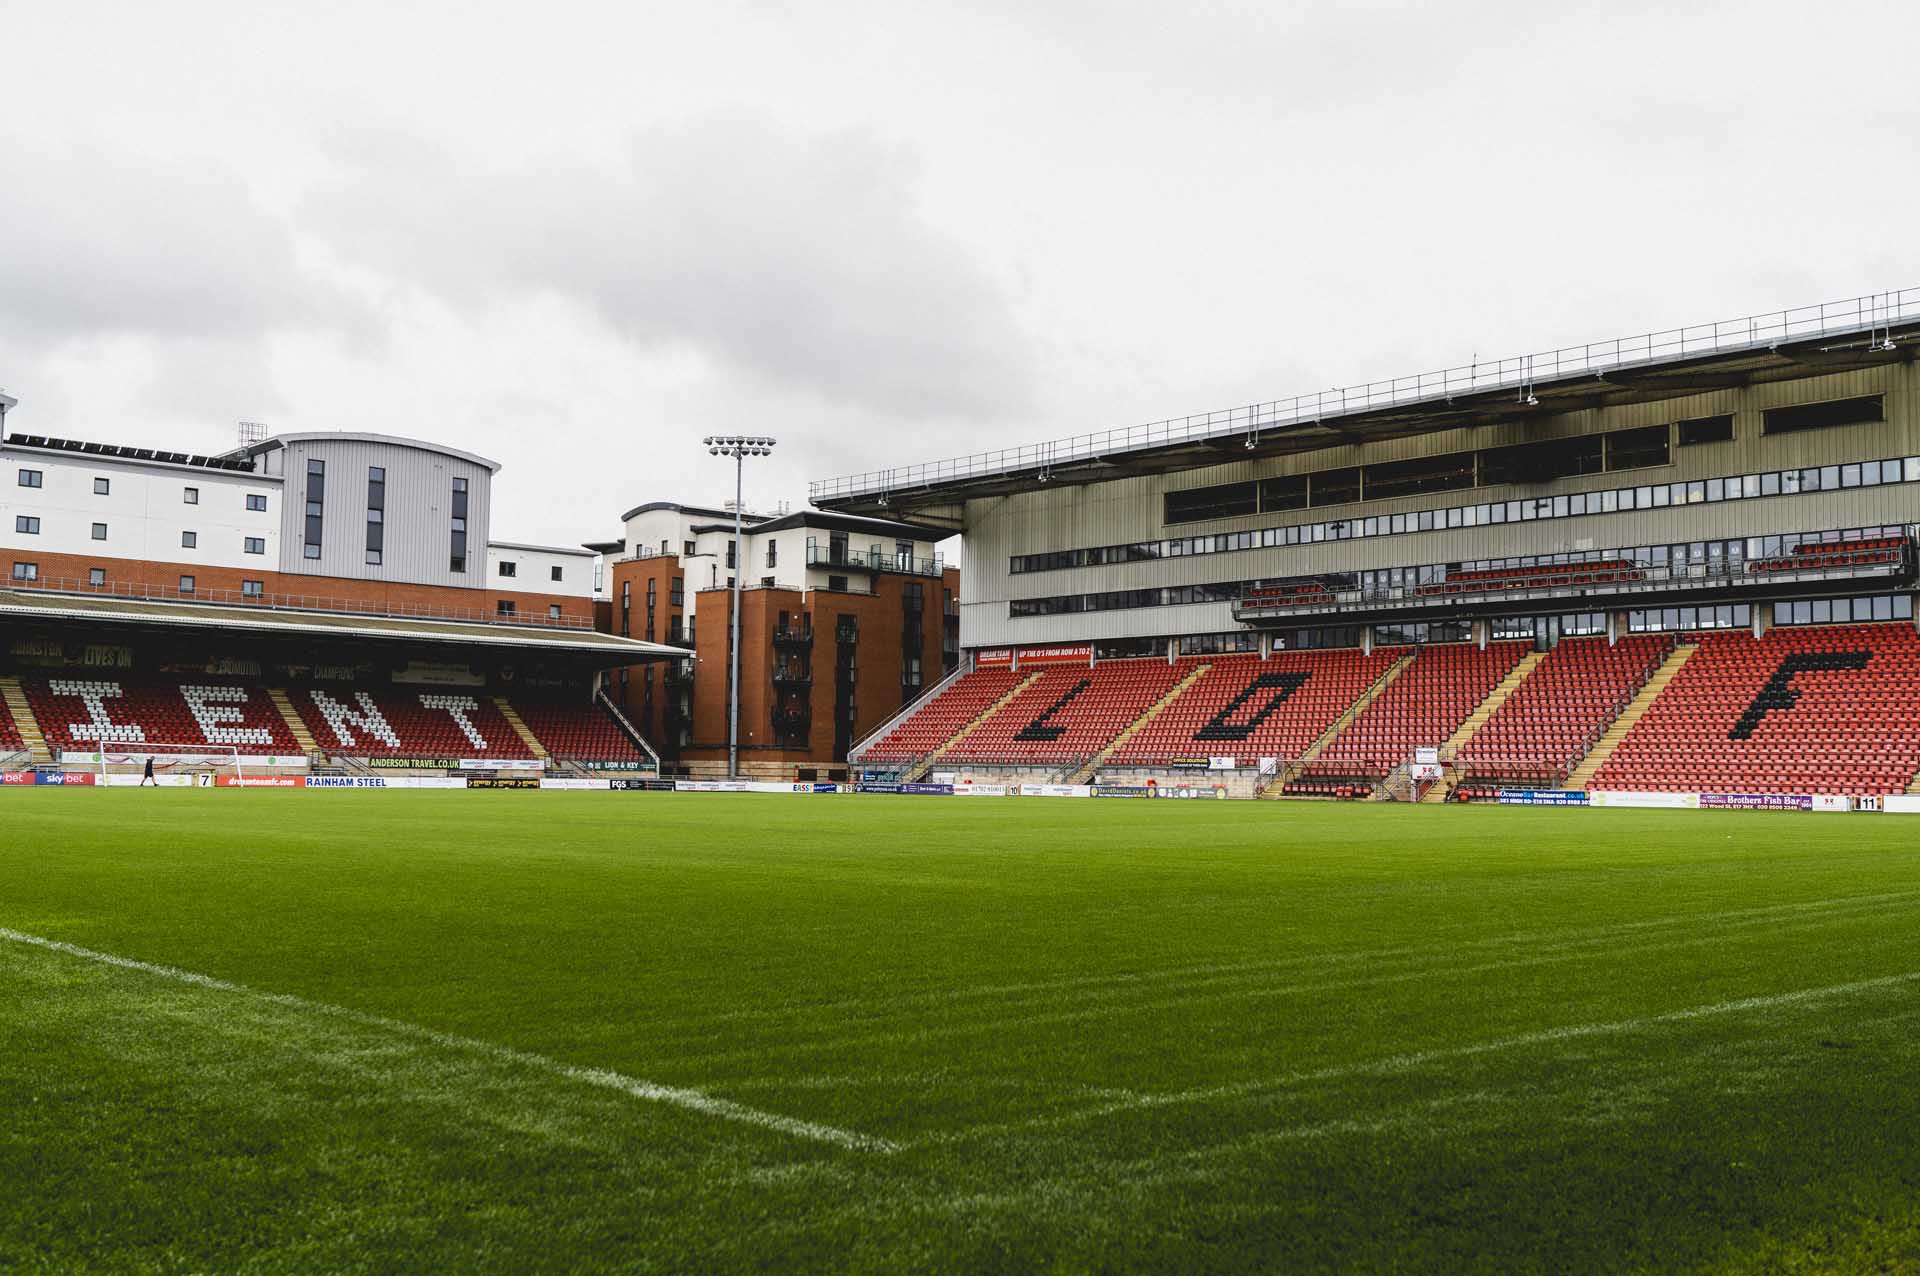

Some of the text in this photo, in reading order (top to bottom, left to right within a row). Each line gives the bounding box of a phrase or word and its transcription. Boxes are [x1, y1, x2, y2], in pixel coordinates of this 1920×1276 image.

[1019, 650, 1026, 658] UP
[1037, 649, 1045, 657] O'S
[1046, 649, 1060, 657] FROM
[1061, 648, 1074, 656] ROW
[370, 758, 459, 769] ANDERSON TRAVEL.CO.UK
[5, 774, 24, 782] bet
[46, 775, 84, 784] sky bet
[201, 775, 209, 786] 7
[306, 777, 387, 787] RAINHAM STEEL
[611, 780, 627, 788] FGS
[1727, 795, 1800, 805] Brothers Fish Bar
[1862, 798, 1875, 809] 11
